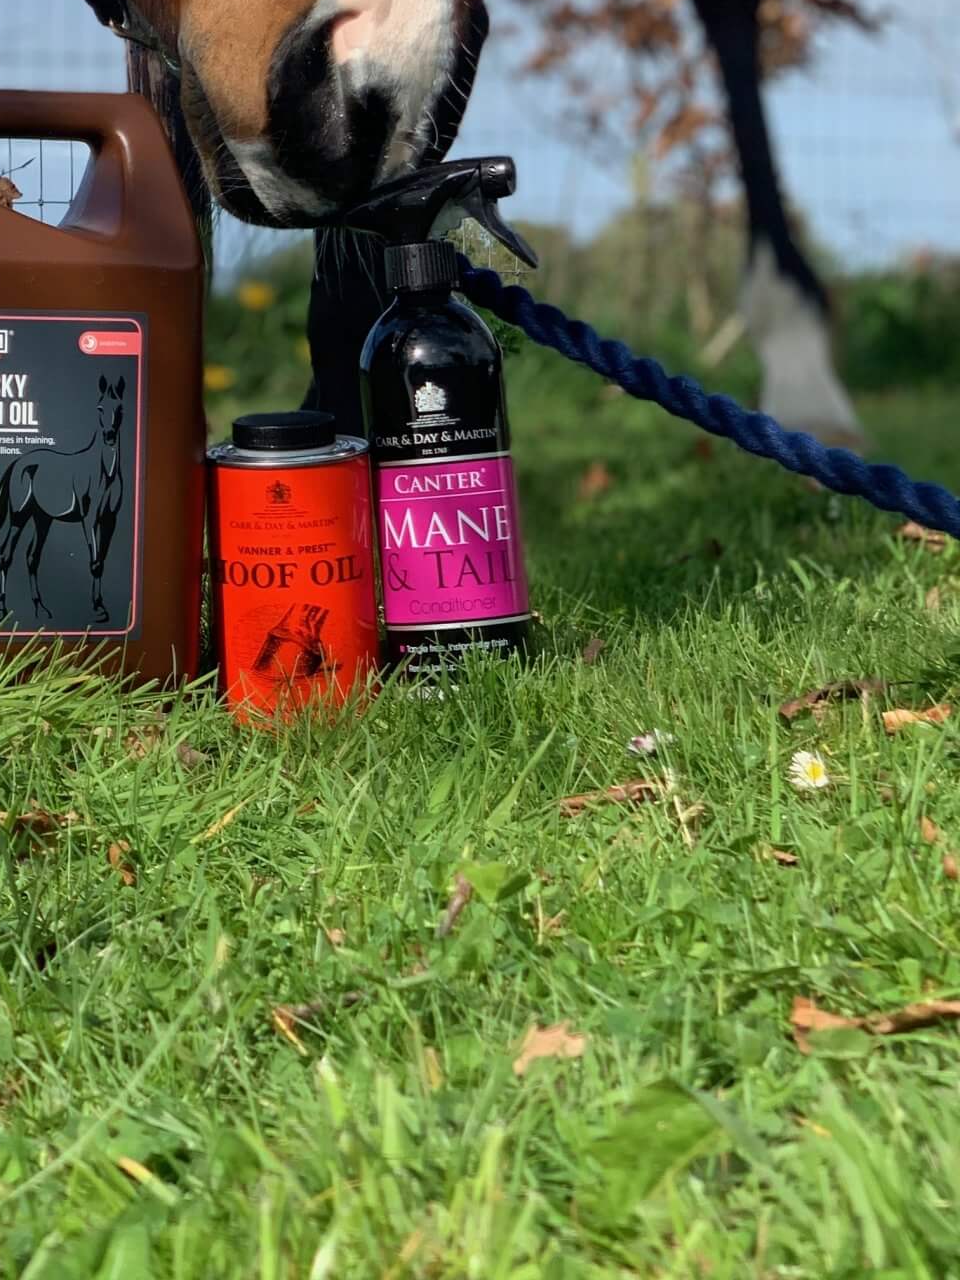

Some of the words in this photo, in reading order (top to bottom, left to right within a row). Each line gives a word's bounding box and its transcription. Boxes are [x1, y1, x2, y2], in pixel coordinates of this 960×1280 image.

[9, 401, 39, 425] OIL
[15, 435, 24, 444] in
[376, 437, 402, 448] CARR
[401, 434, 413, 445] &
[413, 433, 438, 445] DAY
[441, 430, 454, 442] &
[454, 428, 497, 441] MARTIN
[394, 471, 486, 494] CANTER
[254, 521, 262, 530] &
[265, 521, 284, 530] DAY
[287, 520, 296, 530] &
[384, 505, 511, 549] MANE
[238, 545, 282, 555] VANNER
[286, 546, 294, 555] &
[310, 554, 362, 586] OIL
[388, 552, 416, 591] &
[424, 550, 516, 589] TAIL
[409, 596, 497, 615] Conditioner
